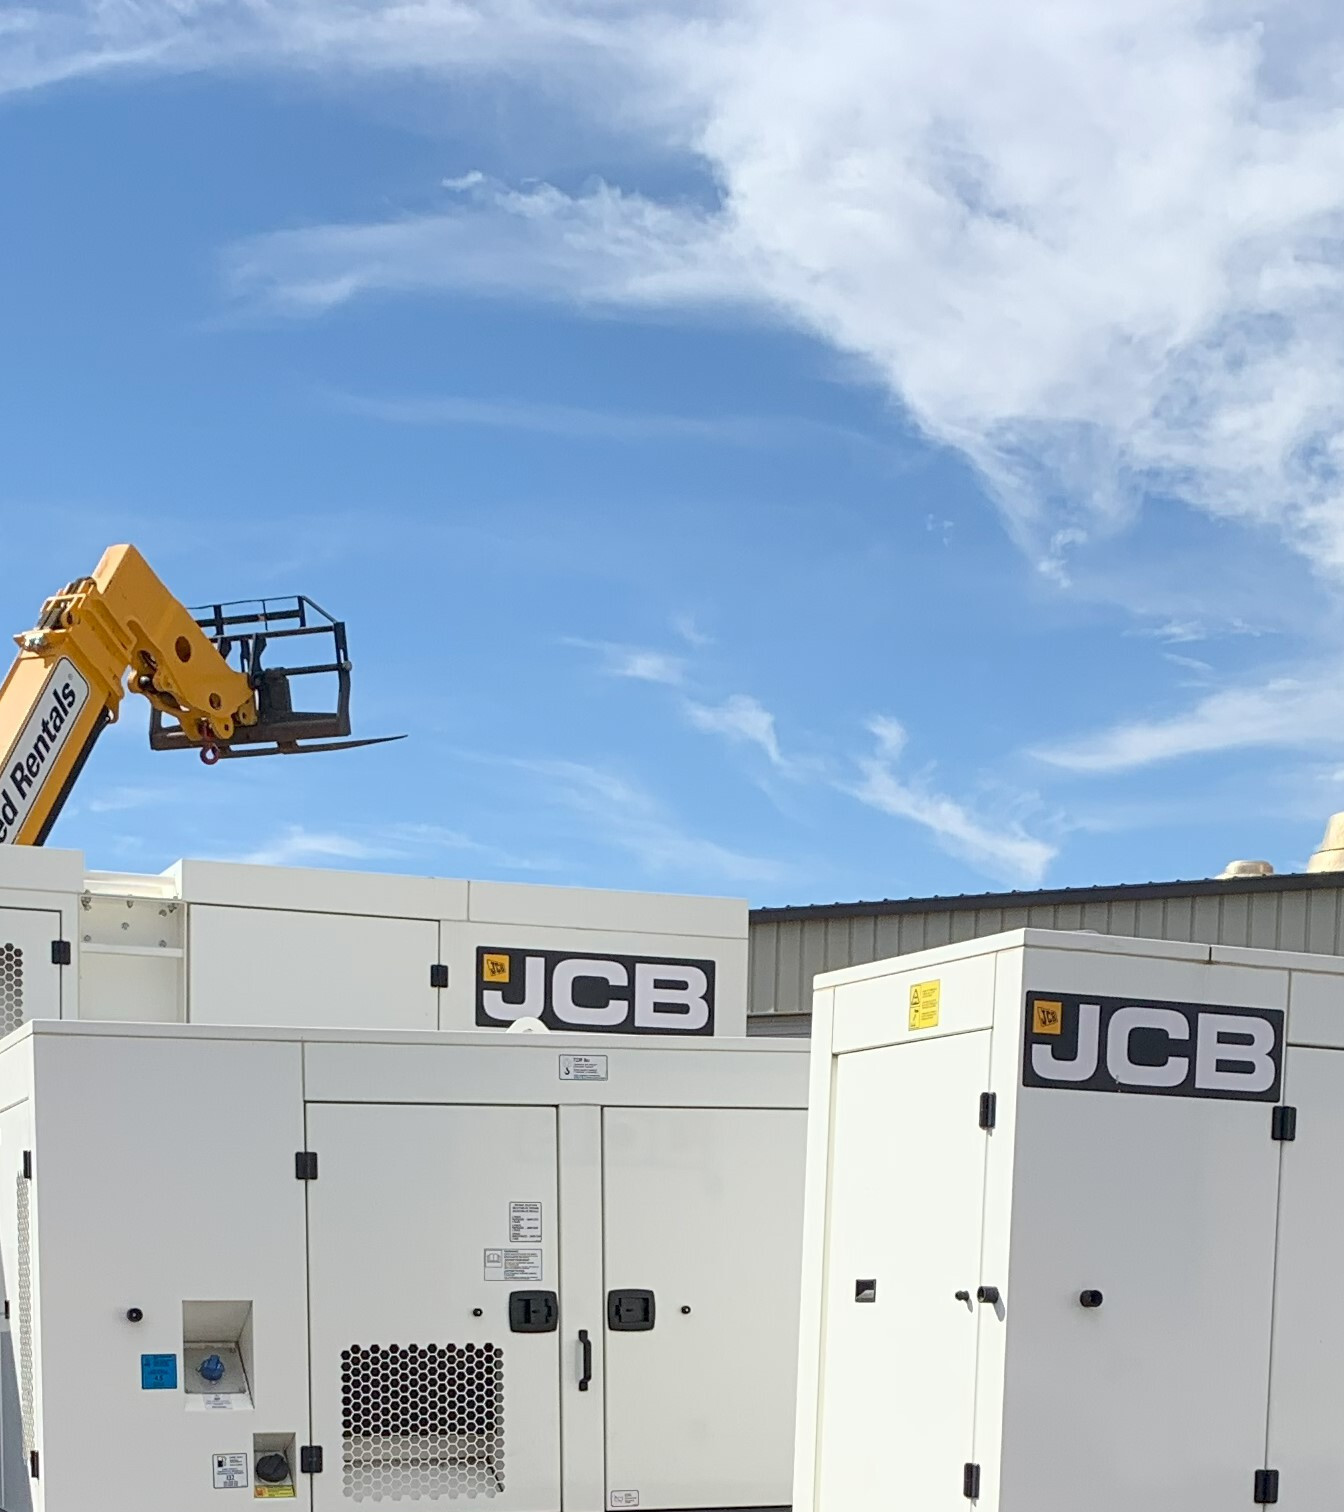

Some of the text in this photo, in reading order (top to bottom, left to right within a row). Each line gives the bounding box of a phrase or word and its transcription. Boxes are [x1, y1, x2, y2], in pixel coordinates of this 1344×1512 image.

[9, 681, 77, 800] Rentals
[483, 956, 710, 1030] JCB
[1031, 1004, 1276, 1093] JCB
